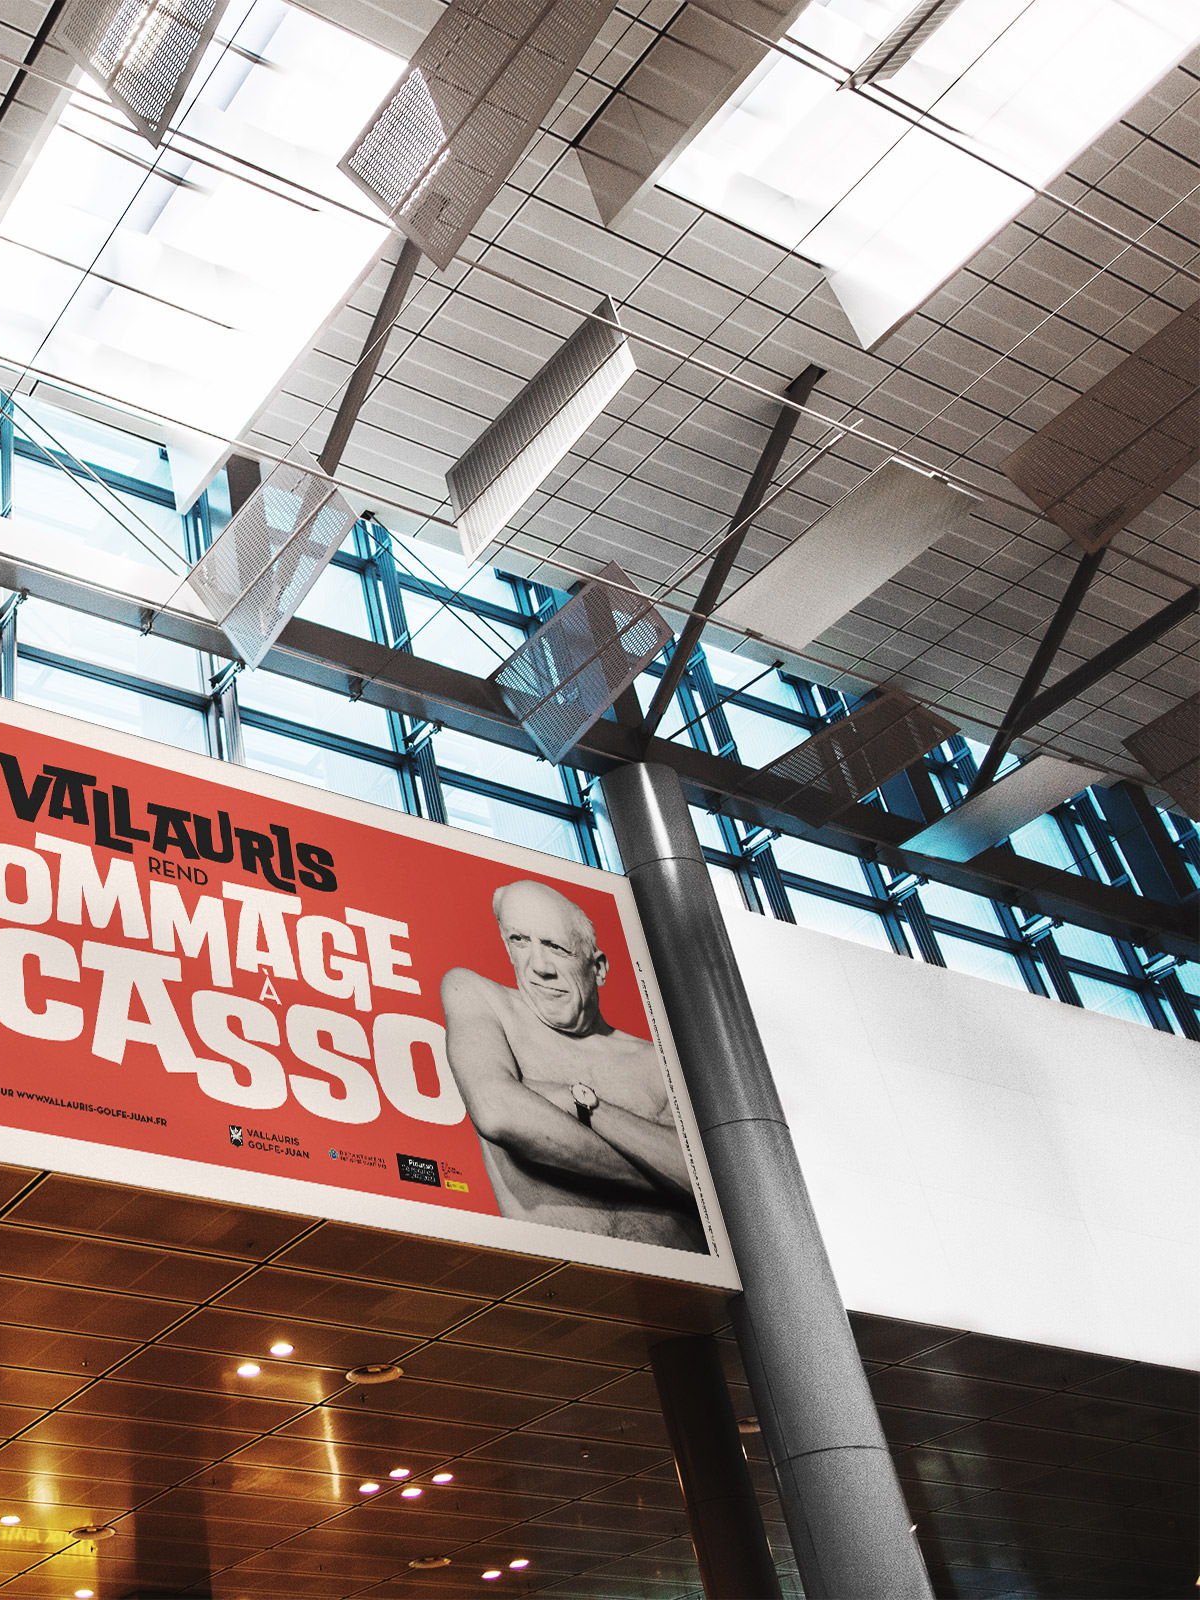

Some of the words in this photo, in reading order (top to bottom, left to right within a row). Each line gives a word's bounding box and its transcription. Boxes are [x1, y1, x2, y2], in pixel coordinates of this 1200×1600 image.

[148, 856, 209, 886] REND
[259, 968, 282, 1006] À
[16, 1090, 167, 1127] WWW.VALLAURIS-GOLFE-JUAN.FR
[247, 1129, 300, 1146] VALLAURIS
[248, 1140, 310, 1159] GOLFE-JUAN
